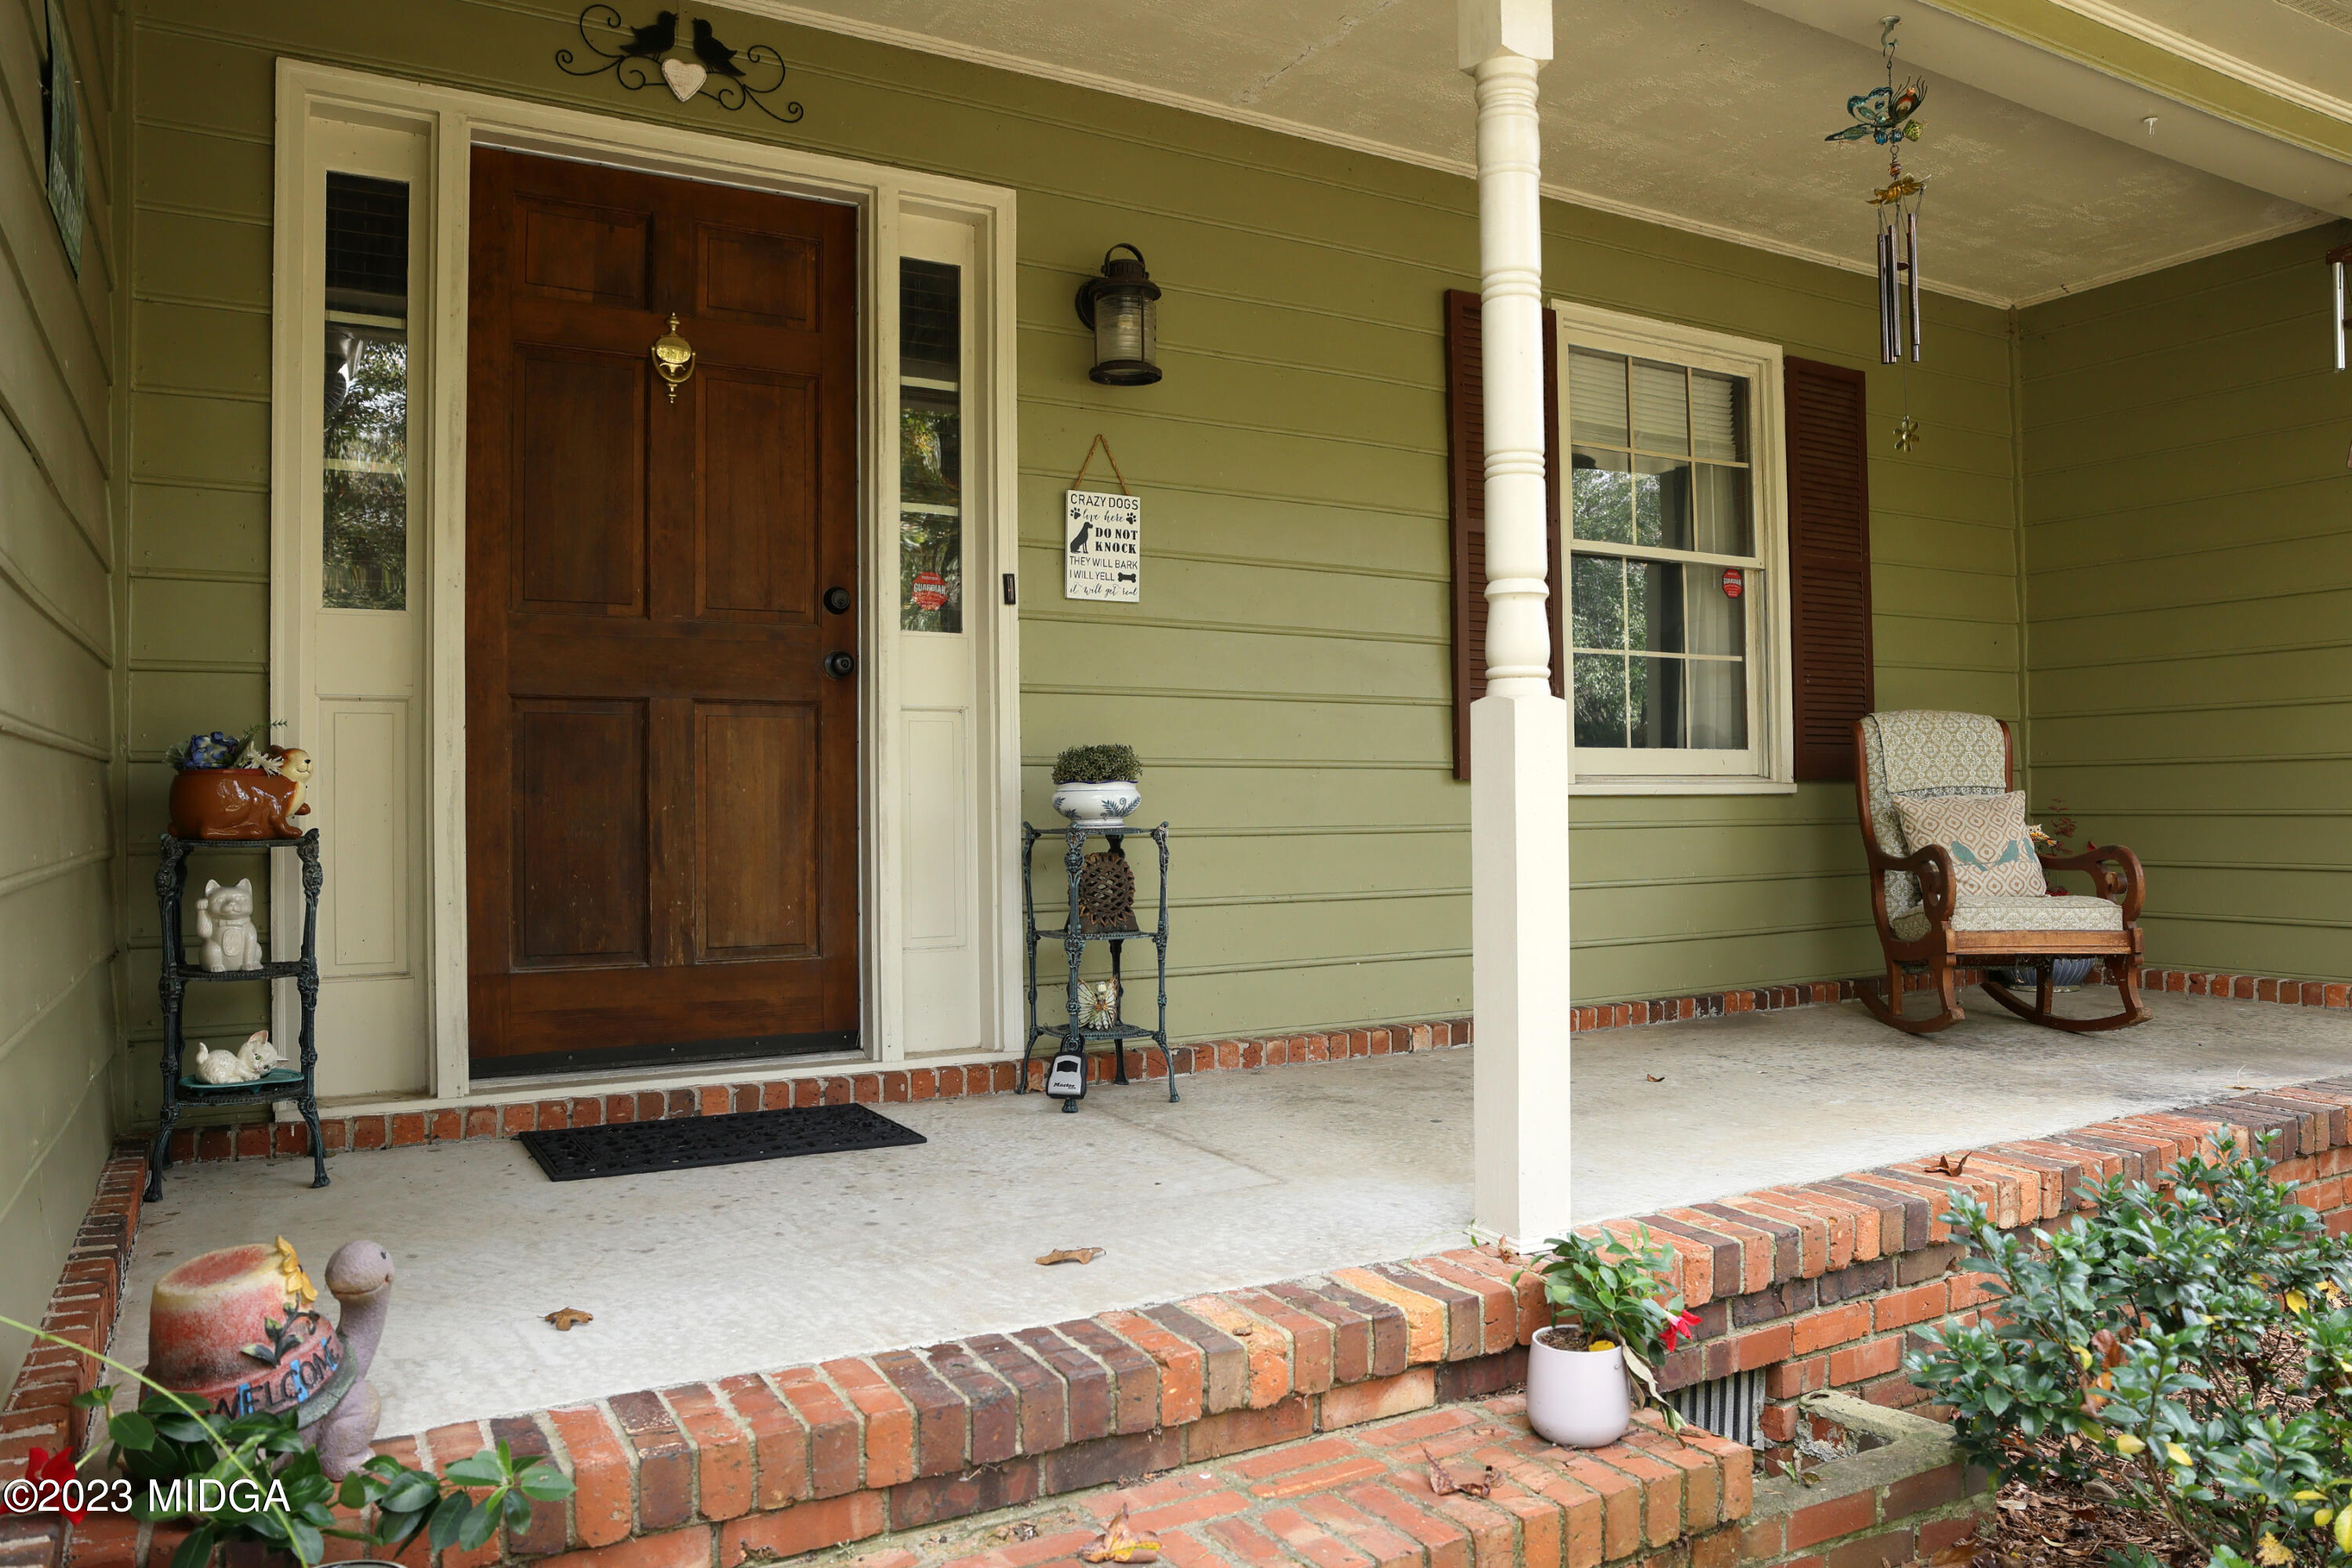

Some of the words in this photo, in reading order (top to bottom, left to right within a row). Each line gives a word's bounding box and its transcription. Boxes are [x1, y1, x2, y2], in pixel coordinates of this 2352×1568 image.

[1071, 493, 1106, 507] CRAZY
[1109, 497, 1138, 510] DOGS
[1083, 508, 1101, 522] live
[1104, 510, 1124, 523] here
[1095, 527, 1112, 539] DO
[1115, 528, 1138, 540] NOT
[1095, 541, 1137, 554] KNOCK
[1069, 555, 1091, 566] THEY
[1092, 557, 1113, 568] WILL
[1115, 559, 1138, 570] BARK
[1073, 570, 1094, 580] WILL
[1095, 572, 1115, 582] YELL
[913, 583, 946, 595] GUARDIAN
[1083, 583, 1104, 596] will
[1105, 583, 1122, 598] get
